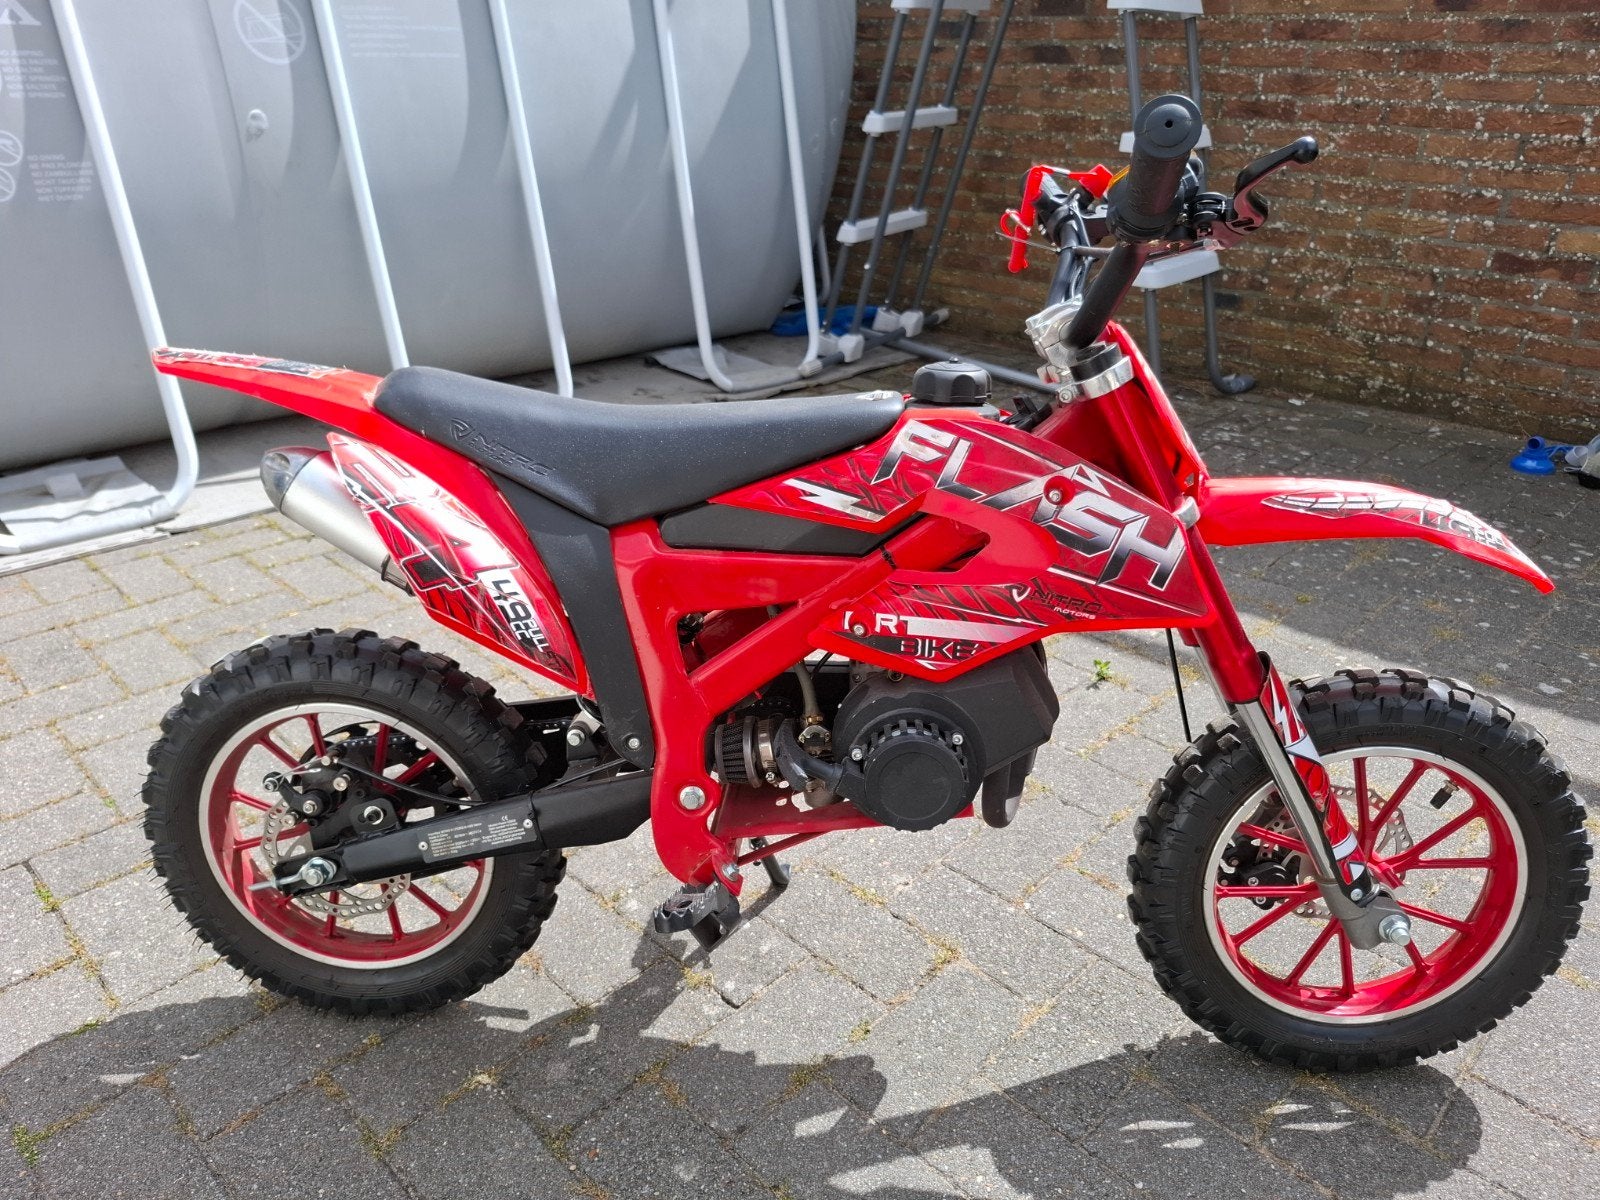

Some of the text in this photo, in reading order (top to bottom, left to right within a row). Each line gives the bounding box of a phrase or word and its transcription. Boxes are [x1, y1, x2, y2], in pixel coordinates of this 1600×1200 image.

[871, 418, 1187, 591] FLASH
[491, 579, 532, 623] 49
[1030, 588, 1104, 615] NITRO
[1053, 606, 1097, 620] MOTORS
[509, 621, 531, 640] CC
[522, 618, 549, 652] PULL
[900, 637, 979, 660] BIKE
